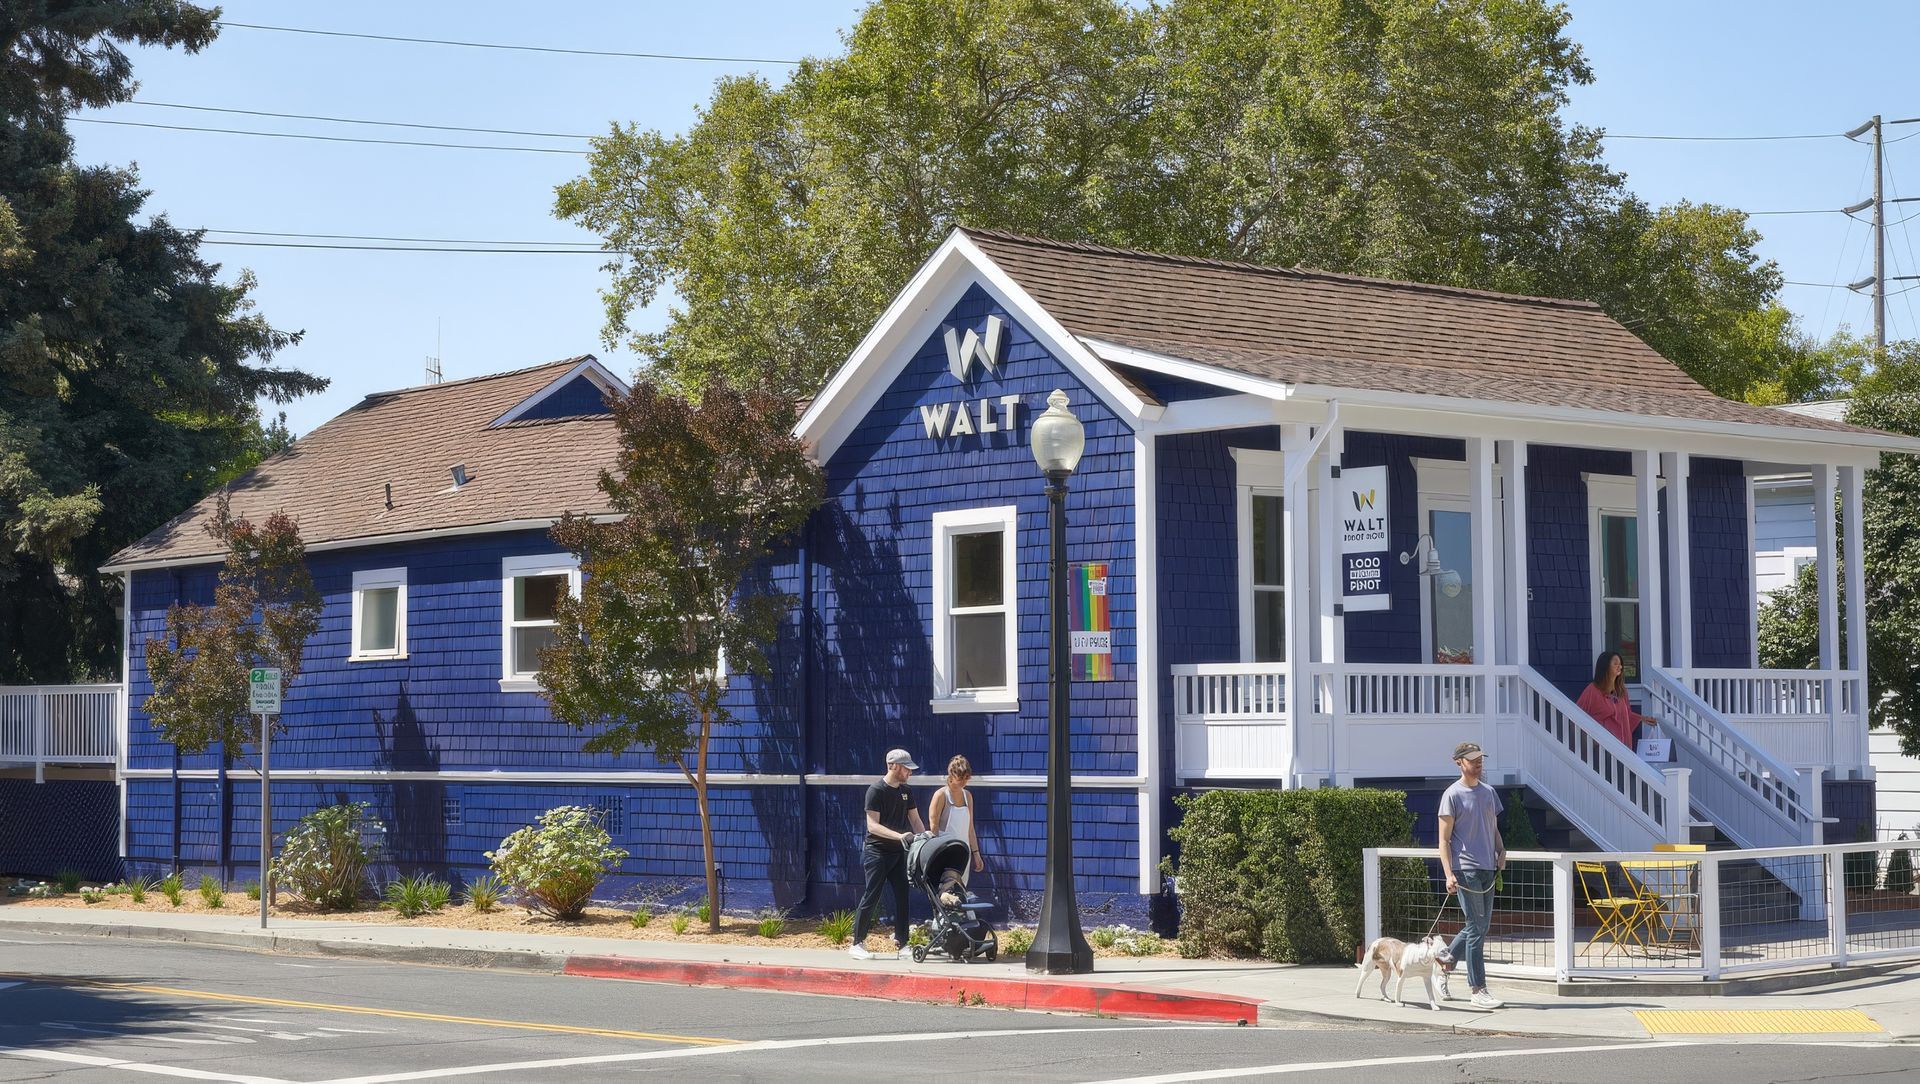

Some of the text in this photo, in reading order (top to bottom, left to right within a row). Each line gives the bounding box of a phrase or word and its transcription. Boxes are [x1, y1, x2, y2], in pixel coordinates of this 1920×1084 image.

[943, 314, 1003, 383] W
[920, 394, 1020, 439] WALT
[1344, 518, 1384, 531] WALT
[1350, 557, 1380, 568] 1000
[254, 671, 262, 681] 2
